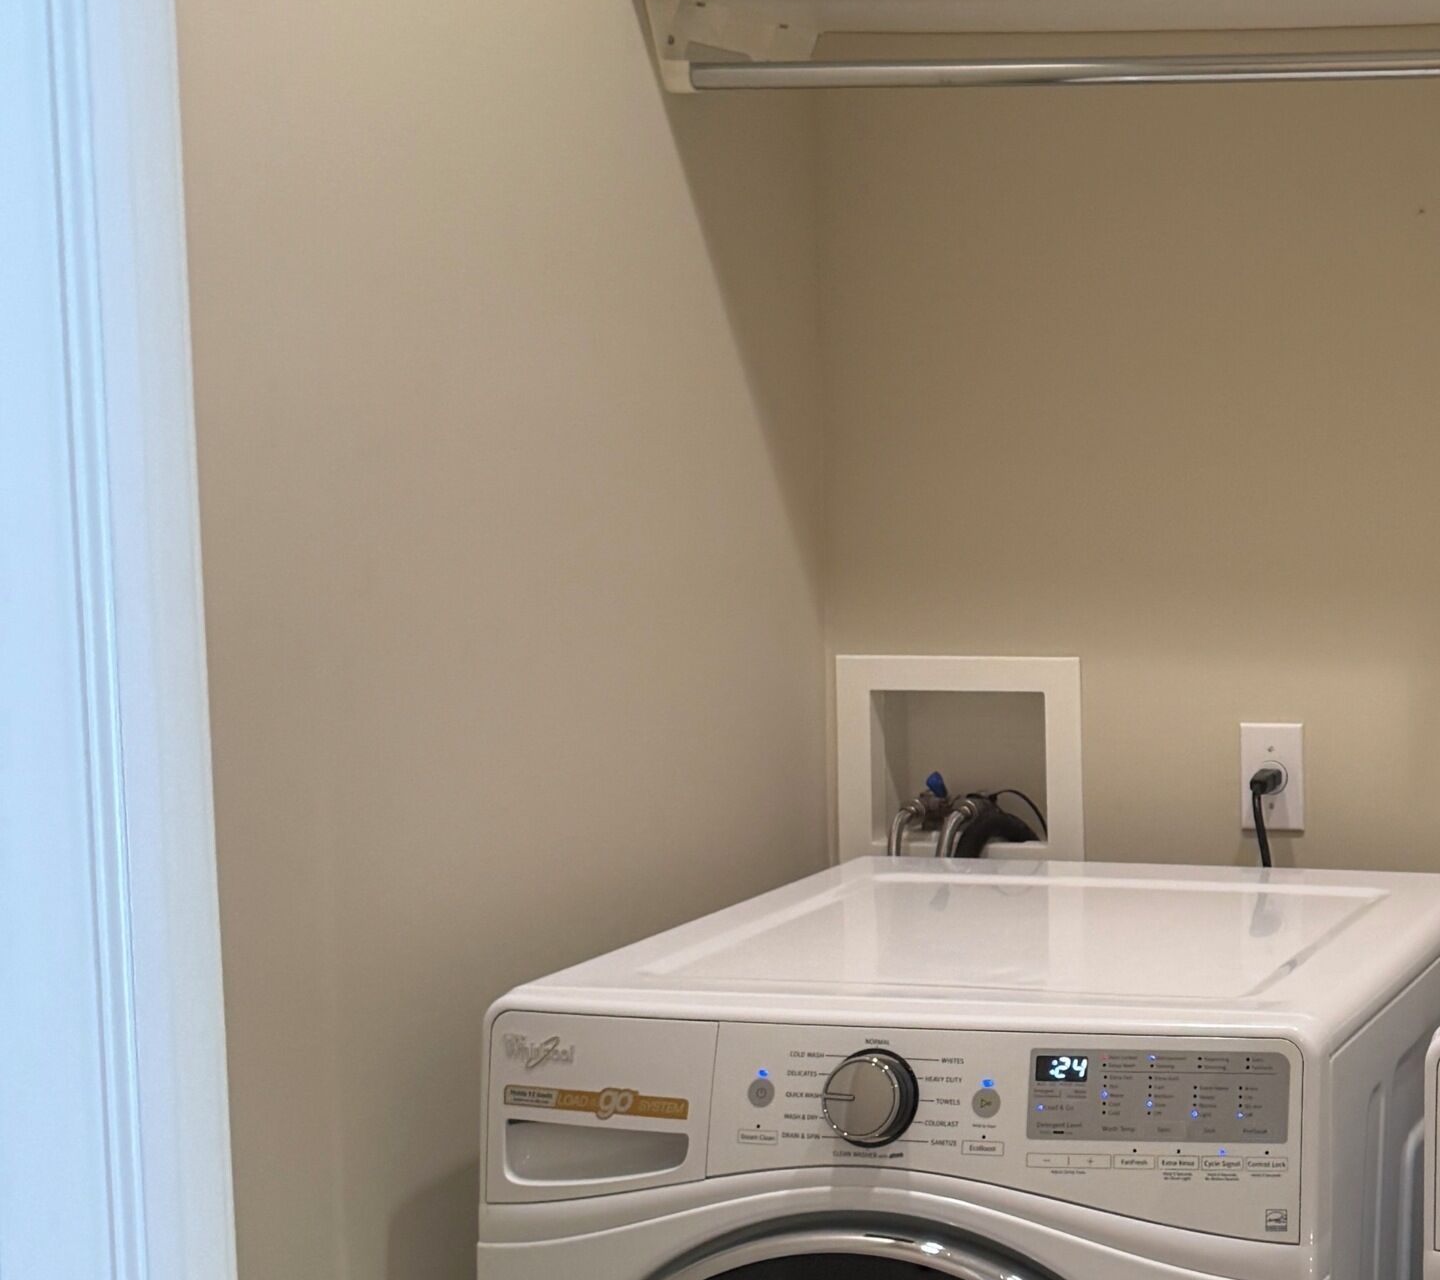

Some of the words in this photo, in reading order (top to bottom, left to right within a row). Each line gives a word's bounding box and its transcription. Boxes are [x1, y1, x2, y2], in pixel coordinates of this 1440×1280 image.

[865, 1038, 890, 1046] NORMAL
[502, 1033, 575, 1070] Whirlpool
[941, 1057, 965, 1065] WHITES
[559, 1094, 590, 1108] LOAD
[597, 1087, 635, 1119] go
[638, 1099, 685, 1114] SYSTEM
[930, 1139, 956, 1147] SANITIZE
[1162, 1157, 1176, 1166] Extra
[1204, 1158, 1221, 1169] Cycle
[1272, 1160, 1286, 1169] Lock
